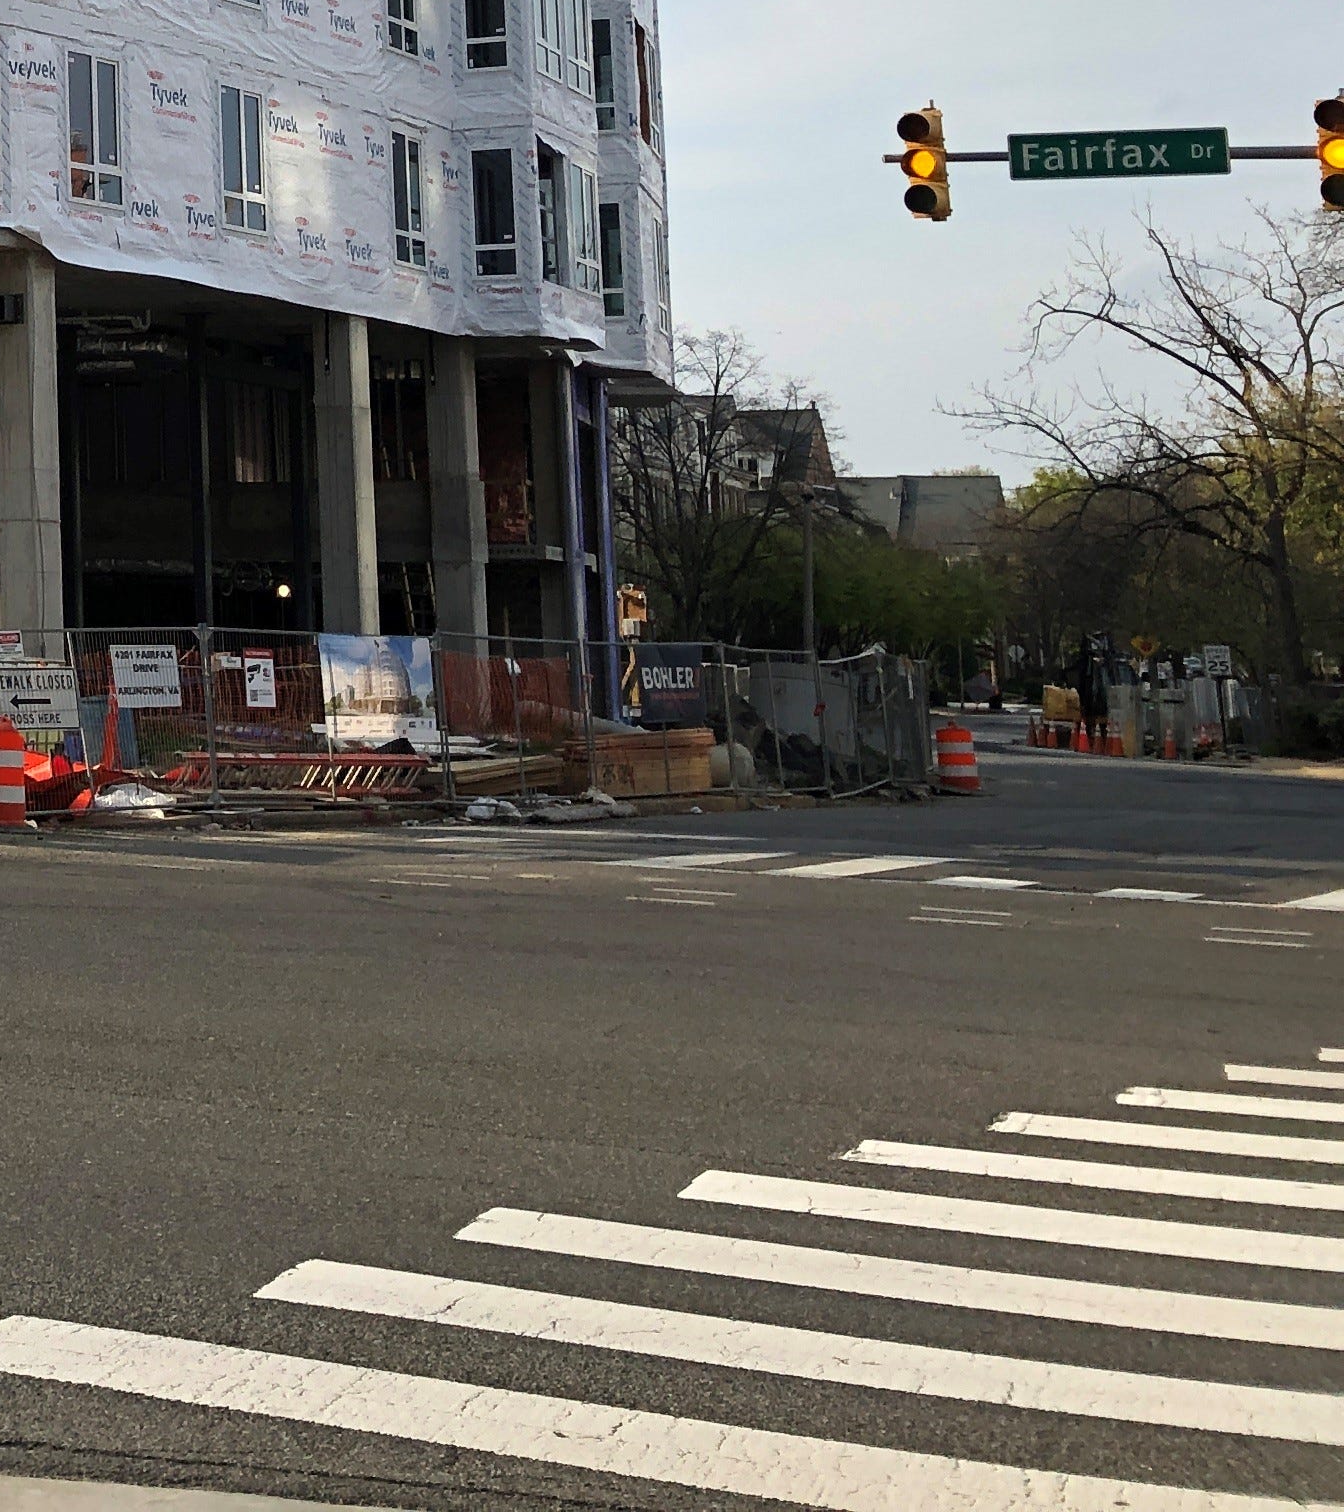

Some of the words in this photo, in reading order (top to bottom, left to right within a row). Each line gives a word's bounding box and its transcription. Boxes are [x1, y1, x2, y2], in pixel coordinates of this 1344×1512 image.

[150, 83, 188, 107] Tyvek
[1022, 138, 1170, 172] Fairfax
[1191, 143, 1215, 159] Dr
[297, 229, 326, 251] Tyvek
[136, 650, 174, 660] FAIRFAX
[132, 663, 159, 673] DRIVE
[1207, 660, 1230, 672] 25
[36, 674, 73, 690] CLOSED
[641, 666, 694, 690] BOHLER
[5, 713, 35, 724] ROSS
[38, 713, 62, 724] HERE
